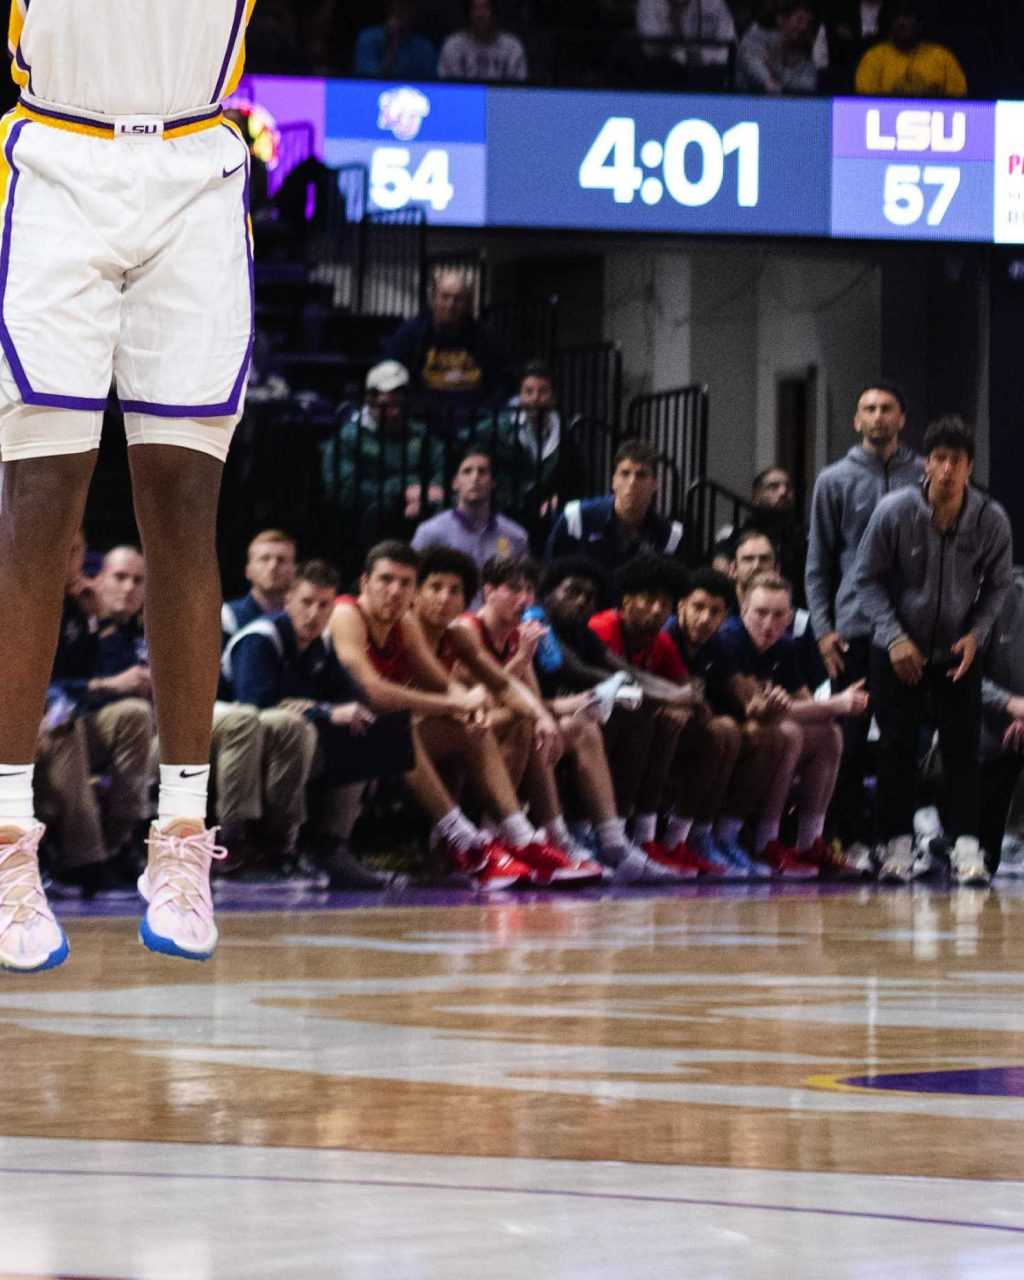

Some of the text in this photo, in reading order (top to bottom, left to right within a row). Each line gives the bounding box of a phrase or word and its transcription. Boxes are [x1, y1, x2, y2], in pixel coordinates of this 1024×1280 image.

[121, 124, 157, 135] LSU
[866, 109, 966, 152] LSU
[369, 147, 454, 210] 54
[579, 117, 760, 207] 4:01
[883, 164, 961, 226] 57
